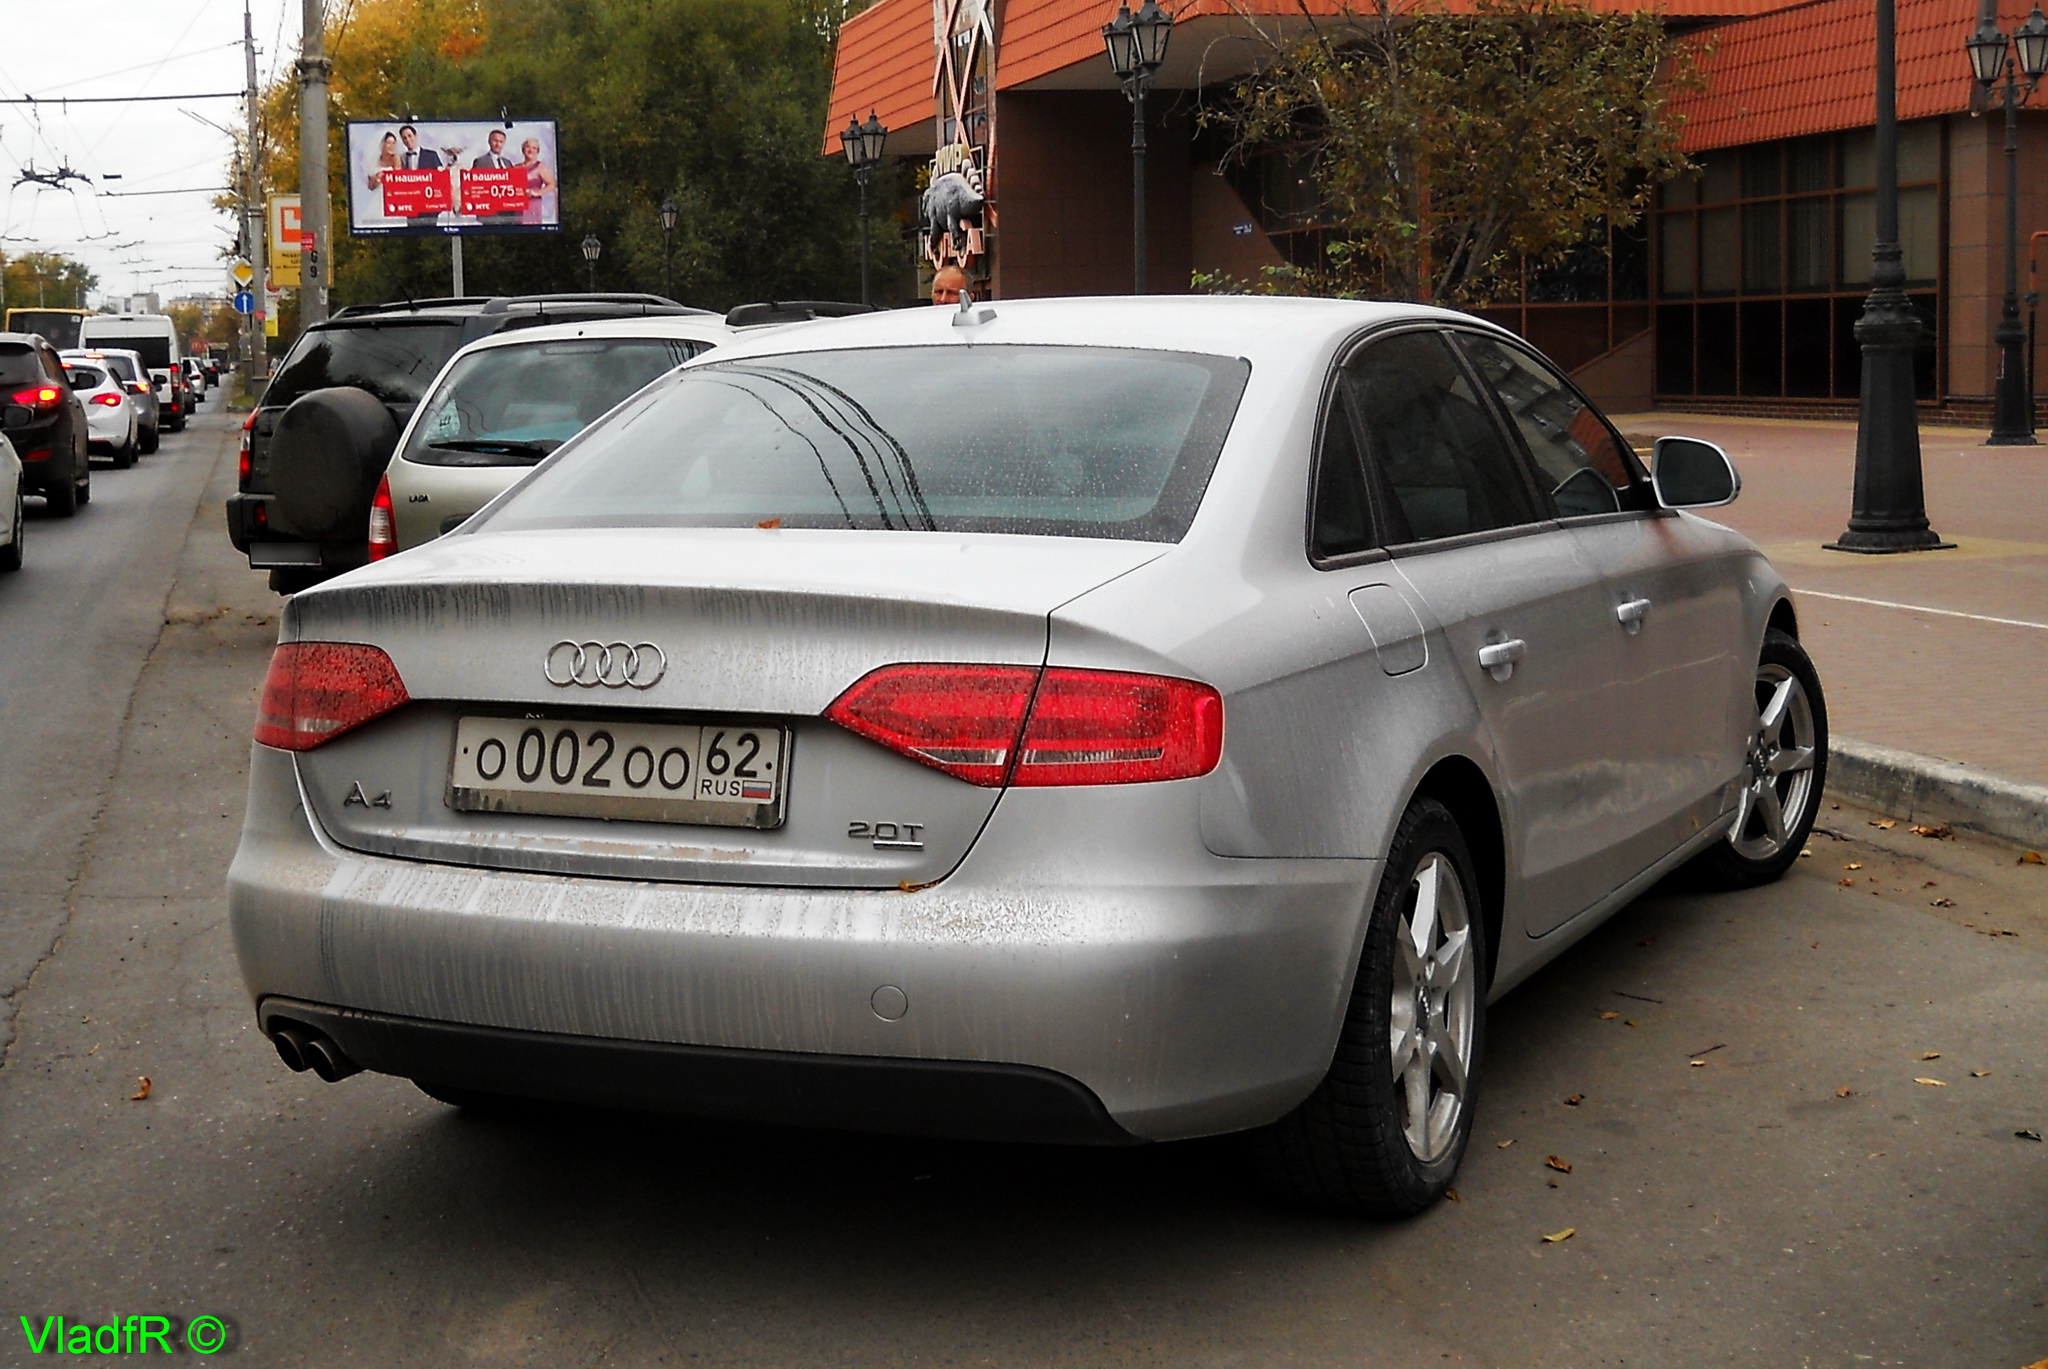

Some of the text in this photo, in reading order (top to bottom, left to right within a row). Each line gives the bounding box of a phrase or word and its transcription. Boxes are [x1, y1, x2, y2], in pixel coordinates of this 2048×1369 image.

[935, 143, 964, 176] МИР
[385, 172, 433, 182] И нашим!
[463, 171, 509, 181] И вашим!
[425, 186, 433, 198] 0
[490, 185, 515, 198] 0,75
[408, 494, 431, 503] LADA
[706, 731, 761, 778] 62
[343, 780, 392, 810] A4
[701, 779, 741, 798] RUS
